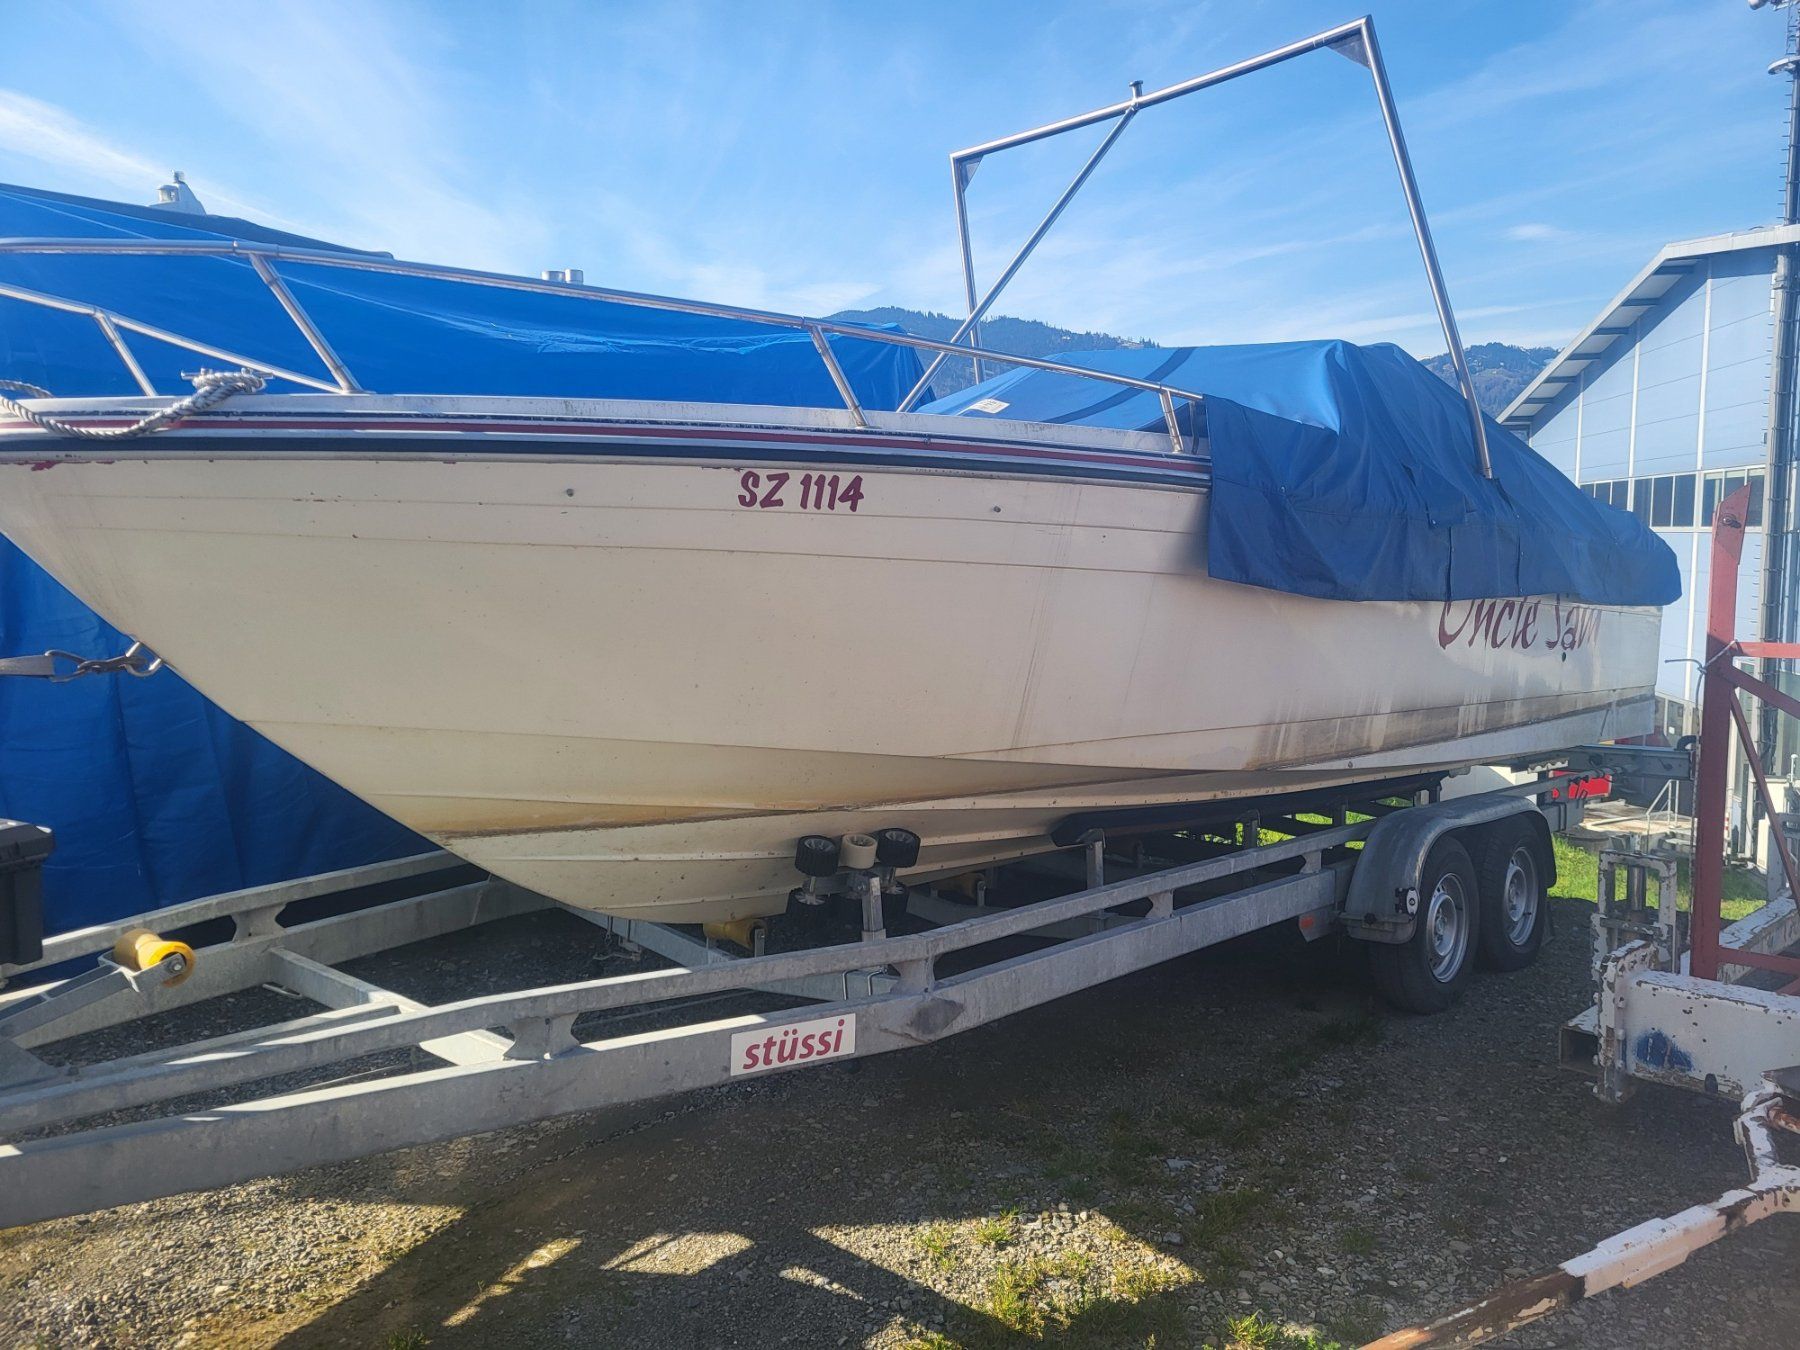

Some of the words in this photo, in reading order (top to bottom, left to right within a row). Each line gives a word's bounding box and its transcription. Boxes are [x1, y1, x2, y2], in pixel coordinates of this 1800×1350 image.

[738, 470, 790, 508] SZ
[800, 473, 864, 512] 1114
[743, 1019, 845, 1070] stüssi
